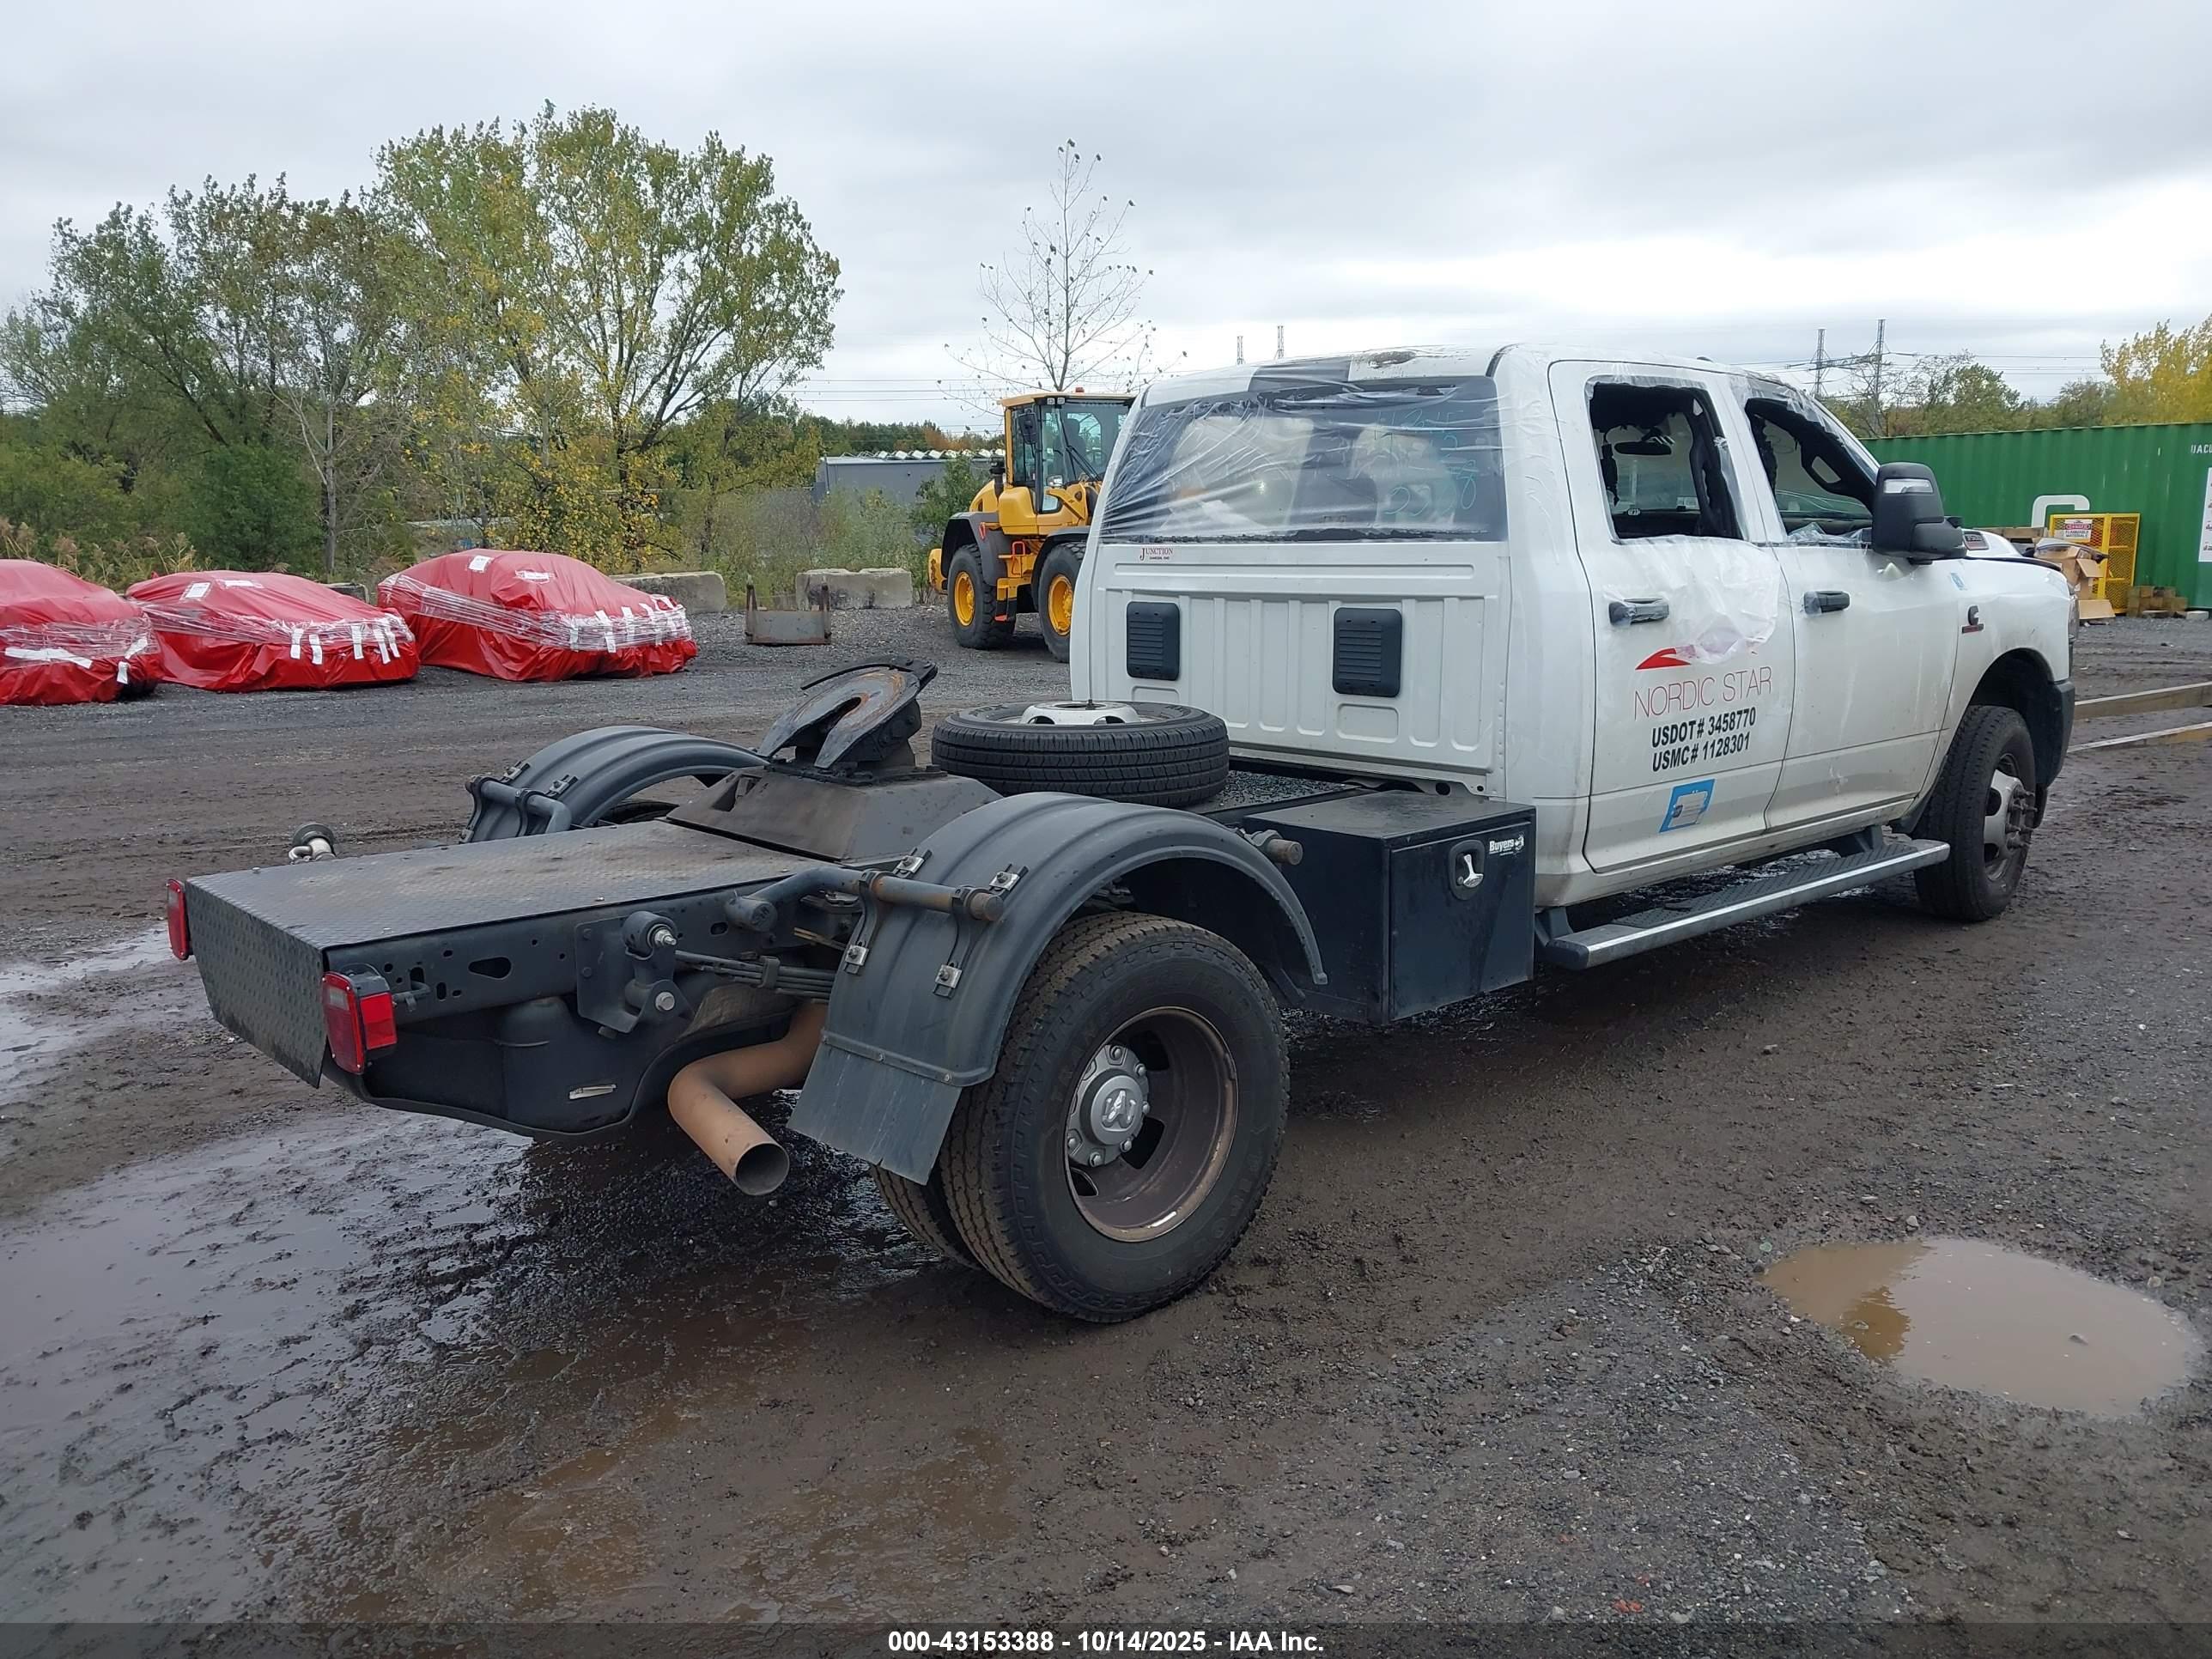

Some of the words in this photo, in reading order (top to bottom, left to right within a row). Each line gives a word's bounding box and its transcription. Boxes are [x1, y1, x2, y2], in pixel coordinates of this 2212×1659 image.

[1634, 677, 1715, 720] NORDIC
[1723, 666, 1772, 702] STAR
[1651, 717, 1705, 748] USDOT#
[1708, 707, 1756, 735] 3458770
[1652, 746, 1699, 772] USMC#
[1702, 732, 1751, 761] 1128301
